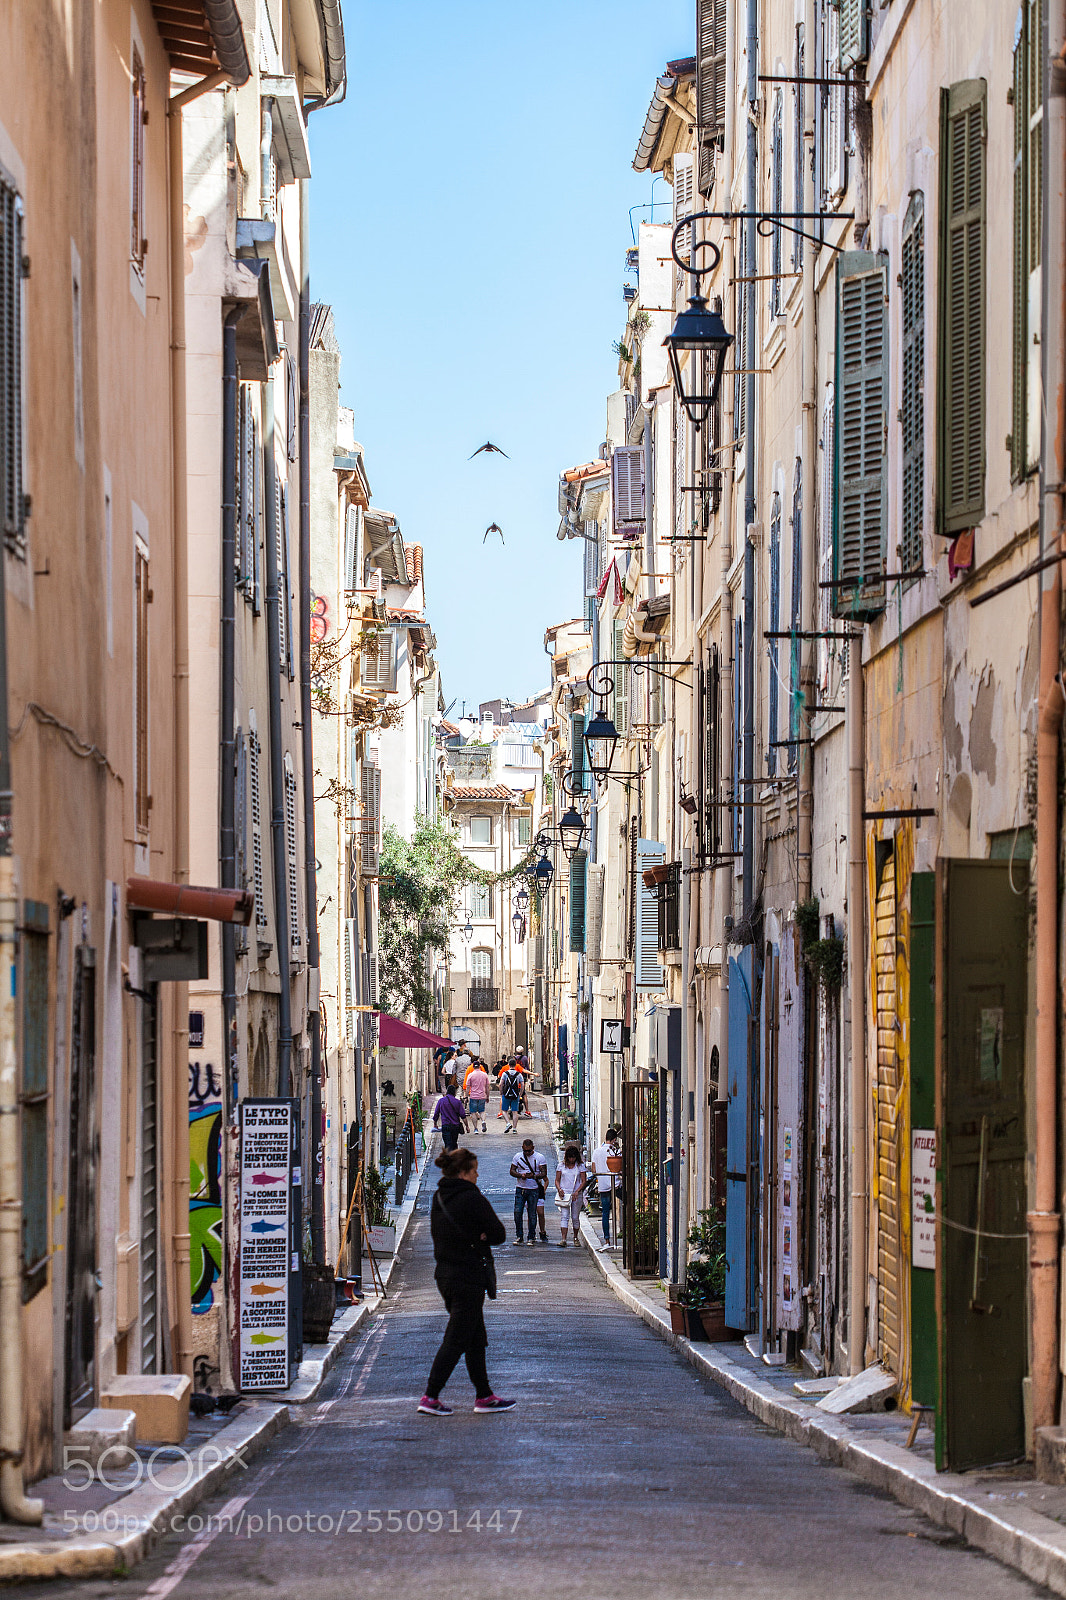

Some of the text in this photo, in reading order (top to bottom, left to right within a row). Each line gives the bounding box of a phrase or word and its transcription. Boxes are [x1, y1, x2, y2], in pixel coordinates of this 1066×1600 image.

[245, 1108, 288, 1117] LE TYPO
[242, 1371, 285, 1380] HISTORIA
